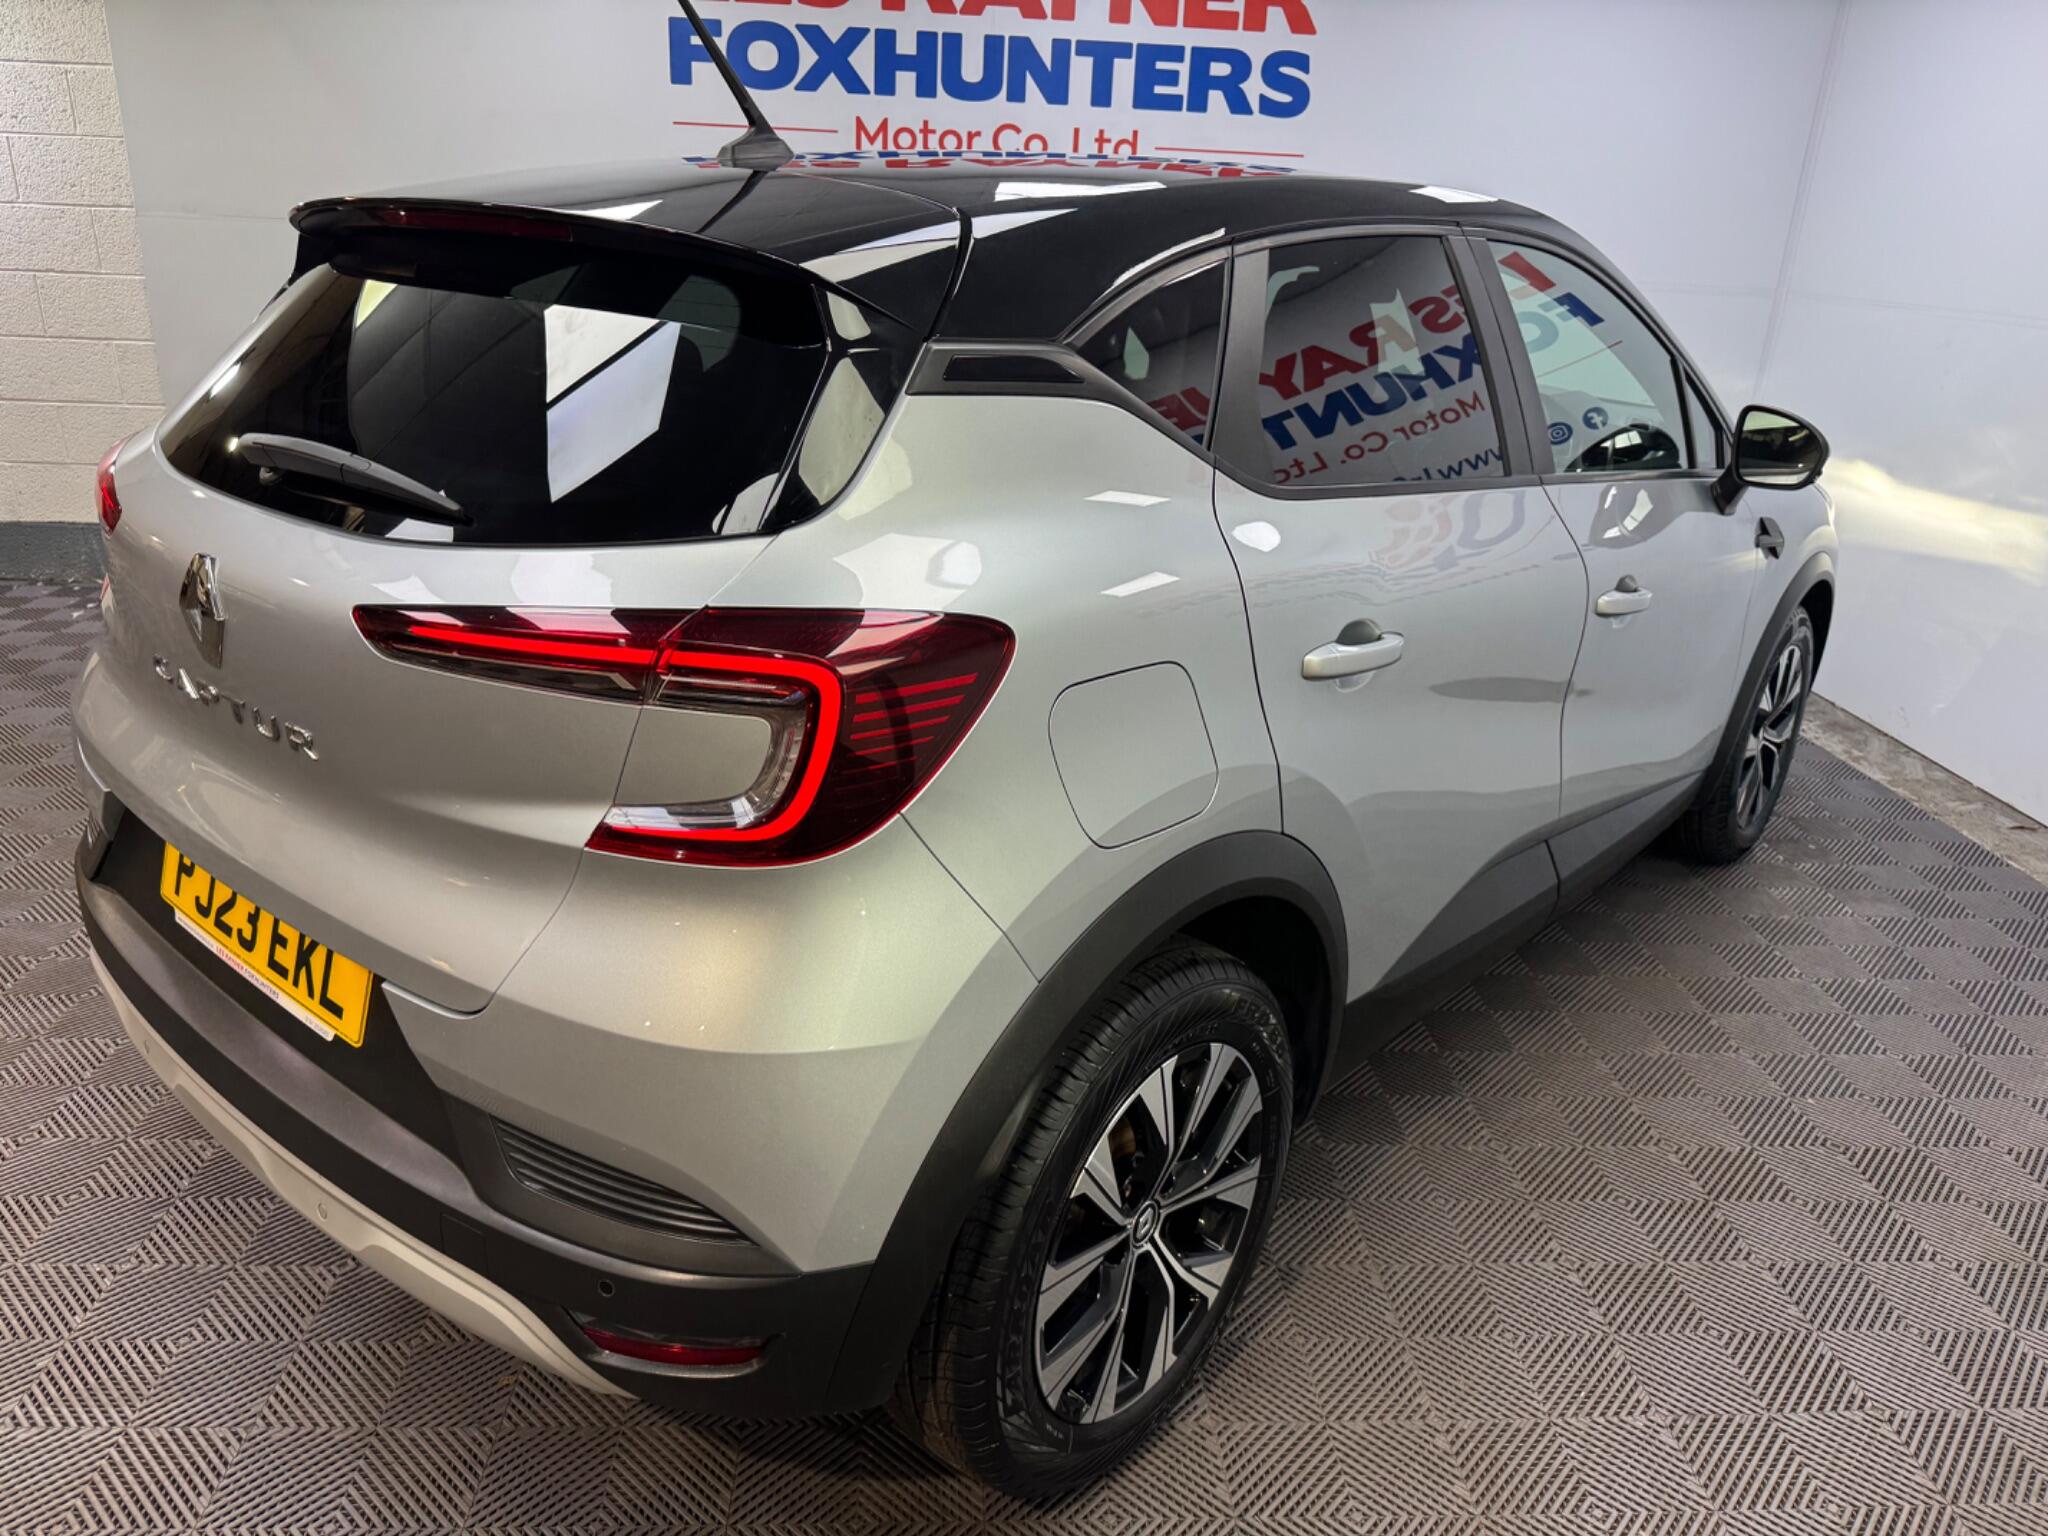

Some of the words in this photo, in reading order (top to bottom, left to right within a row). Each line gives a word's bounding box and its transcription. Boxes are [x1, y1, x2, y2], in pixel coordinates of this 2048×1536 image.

[667, 15, 1312, 119] FOXHUNTERS
[855, 115, 982, 151] Motor
[153, 653, 320, 761] CAPTUR
[174, 851, 261, 954] PJ23
[267, 914, 344, 1021] EKL
